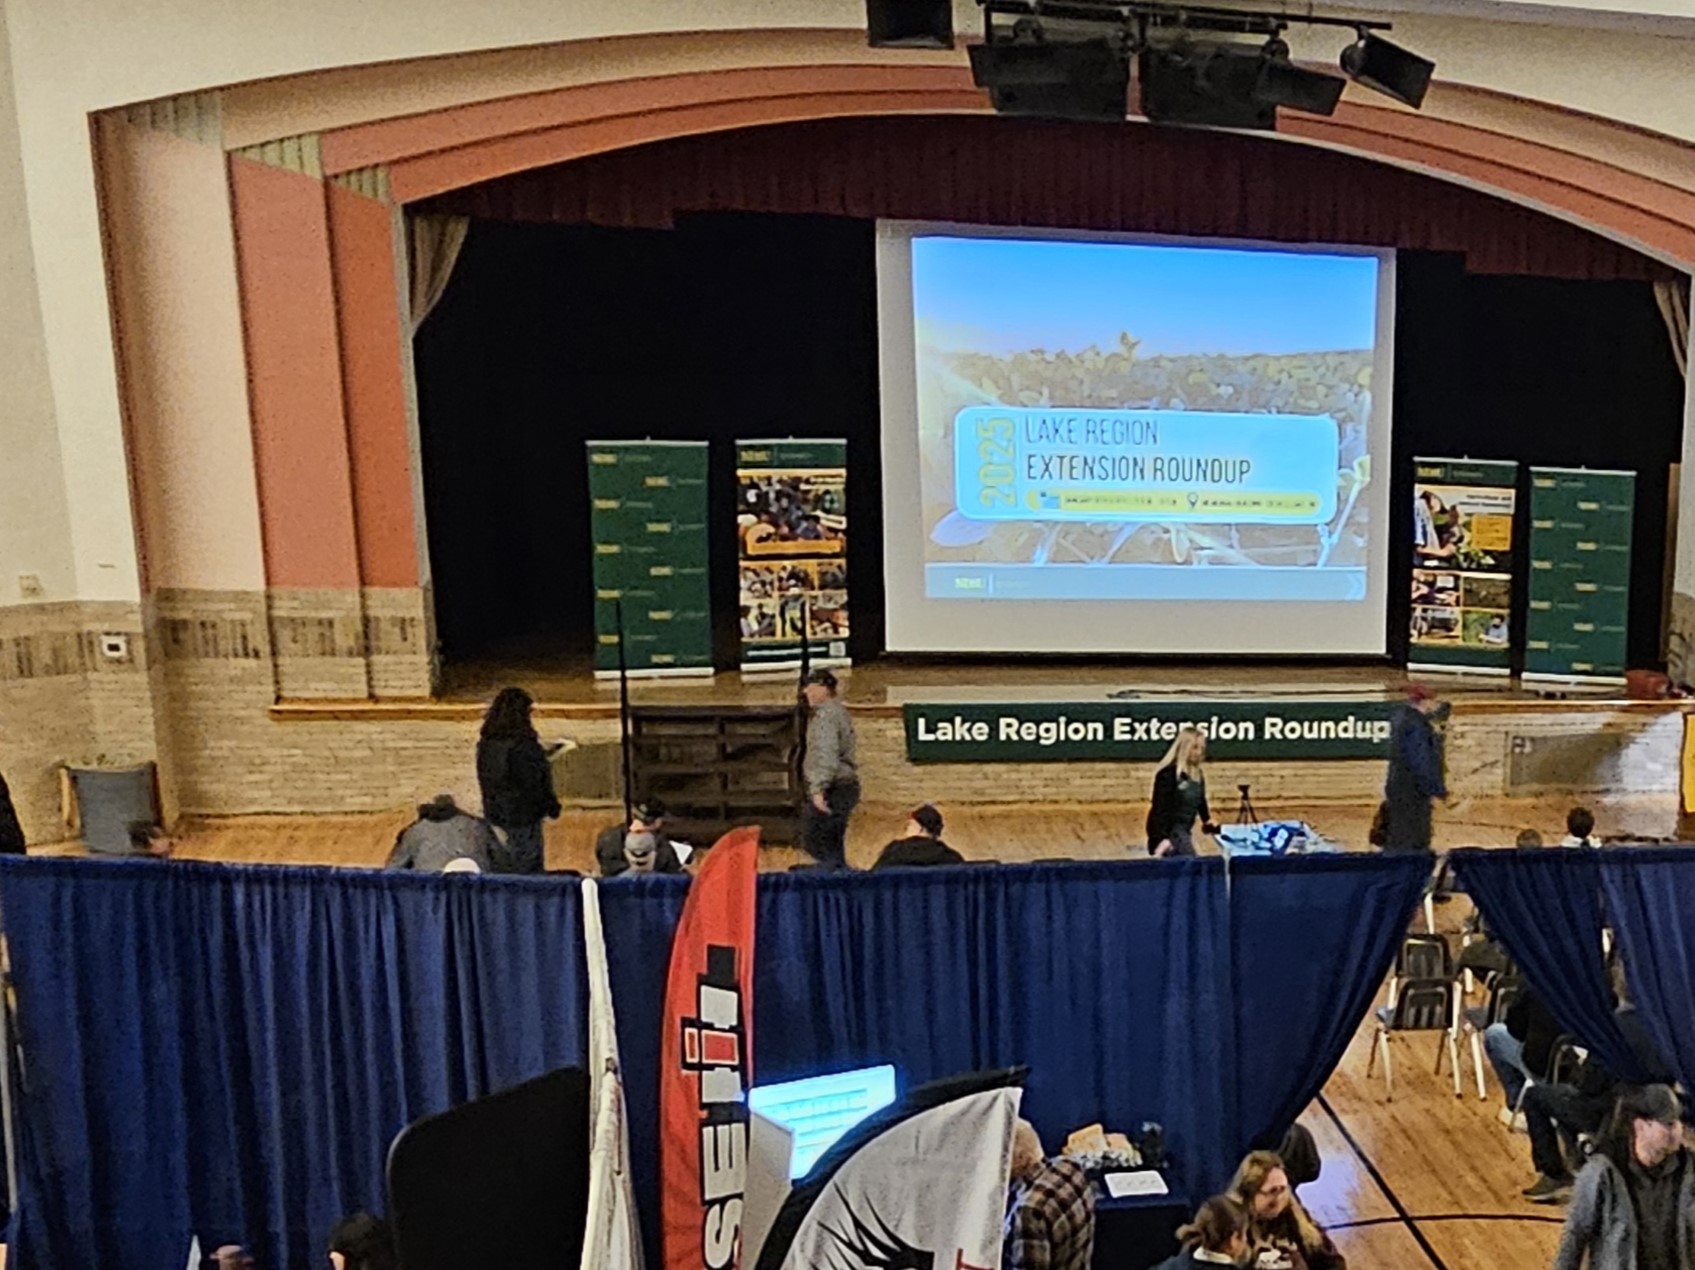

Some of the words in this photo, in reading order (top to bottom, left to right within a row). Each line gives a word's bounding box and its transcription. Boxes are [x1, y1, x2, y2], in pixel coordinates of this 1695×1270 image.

[1025, 415, 1078, 446] LAKE
[1086, 418, 1159, 447] REGION
[976, 416, 1017, 508] 2025
[1026, 454, 1146, 482] EXTENSION
[1153, 456, 1252, 485] ROUNDUP
[917, 717, 990, 742] Lake
[999, 717, 1104, 745] Region
[1113, 716, 1255, 742] Extension
[1264, 715, 1391, 744] Roundup
